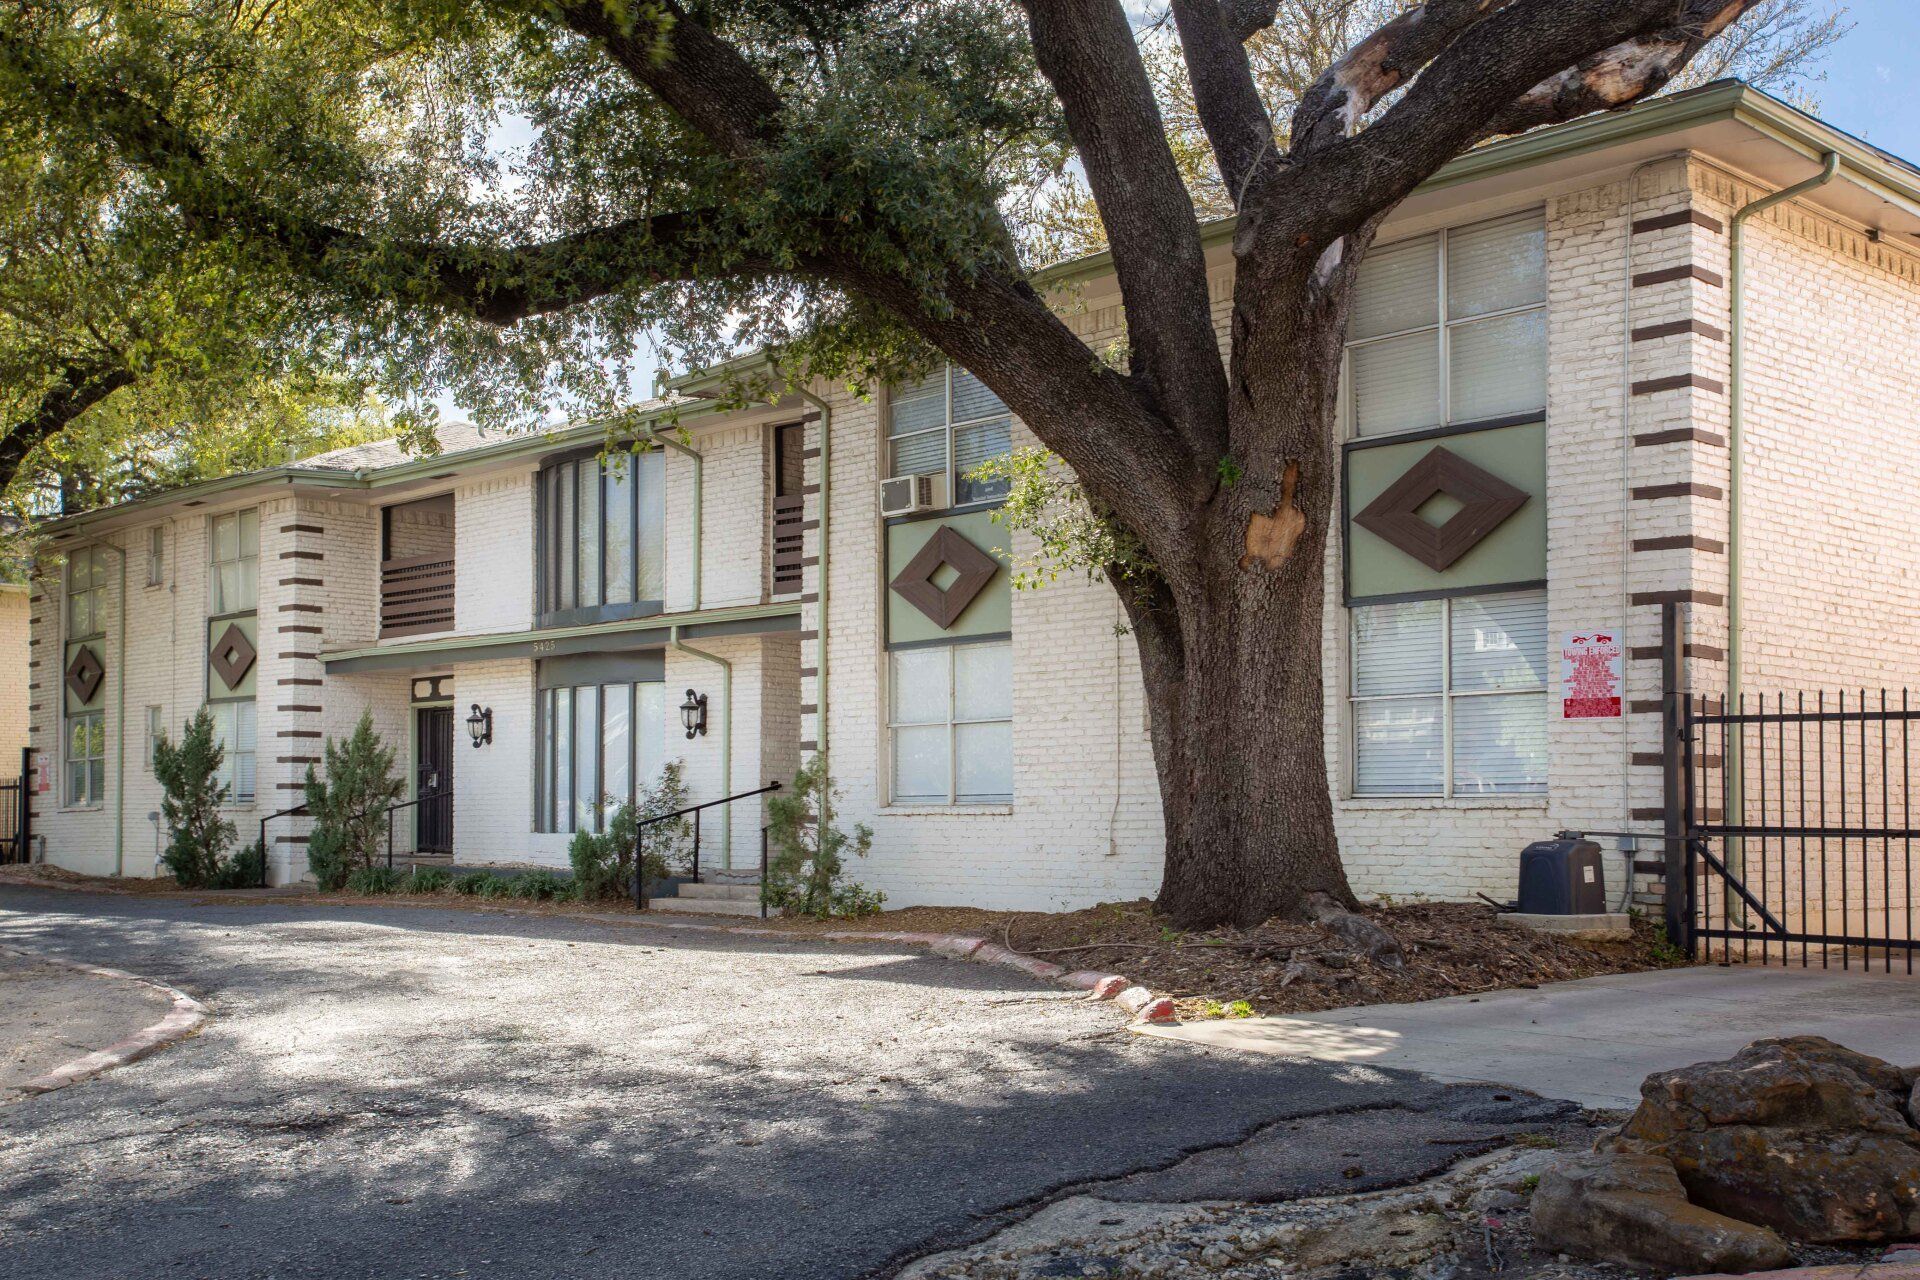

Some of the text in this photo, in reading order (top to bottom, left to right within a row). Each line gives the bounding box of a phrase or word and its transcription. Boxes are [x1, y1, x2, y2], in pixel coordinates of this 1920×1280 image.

[533, 640, 556, 652] 5425
[1564, 645, 1621, 657] TOWING ENFORCED
